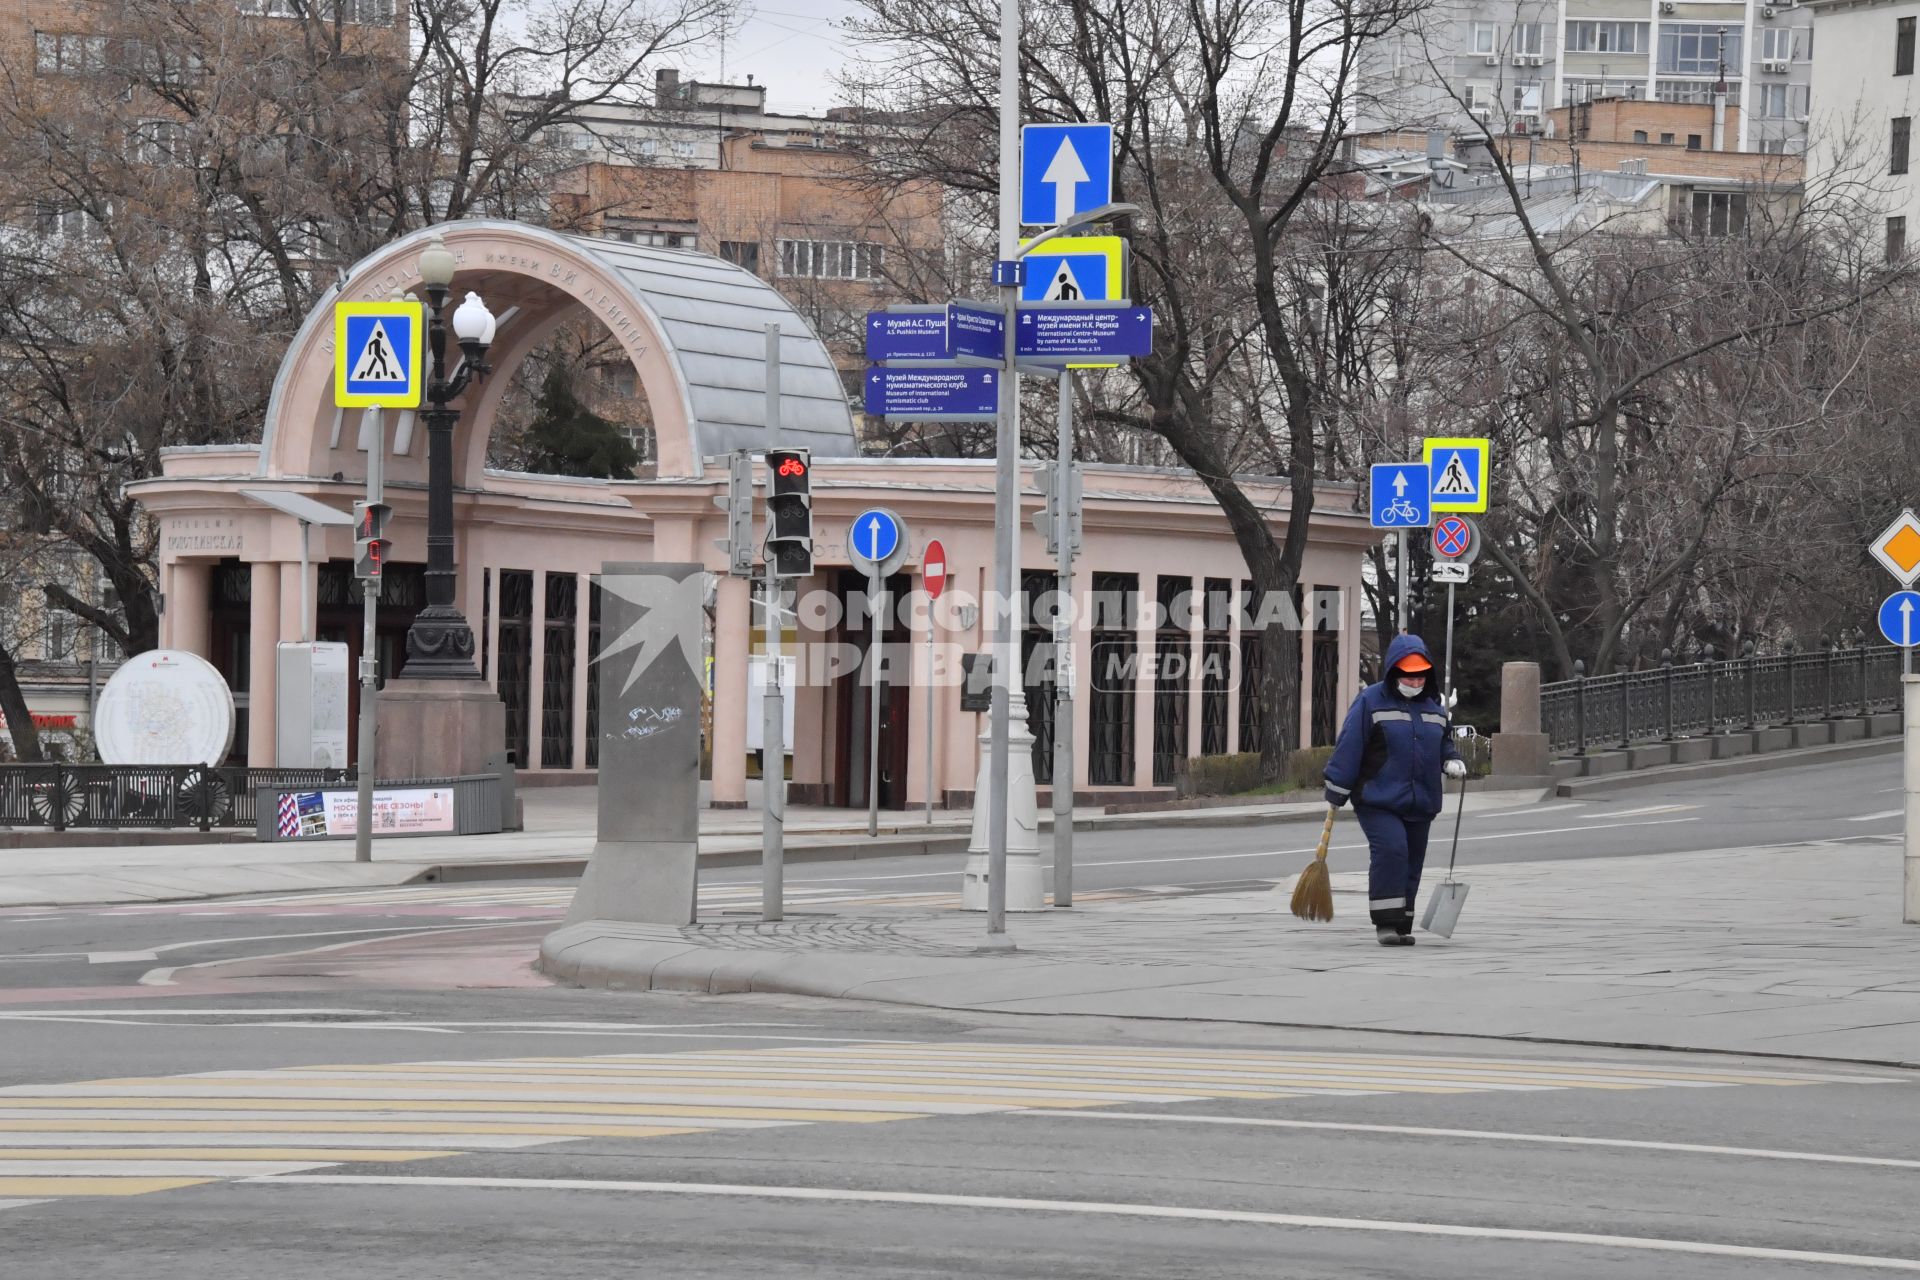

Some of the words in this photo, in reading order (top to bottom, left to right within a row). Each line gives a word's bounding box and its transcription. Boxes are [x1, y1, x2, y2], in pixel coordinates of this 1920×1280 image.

[583, 286, 648, 357] ЛЕНИНА
[1037, 314, 1094, 323] Международный
[1095, 314, 1119, 323] центр-
[887, 319, 911, 329] Музей
[926, 320, 947, 329] Пушк
[1037, 322, 1057, 330] музей
[1095, 322, 1119, 330] Рериха
[886, 374, 907, 382] Музей
[908, 374, 965, 382] Международного
[949, 382, 968, 390] клуба
[390, 802, 423, 810] СЕЗОНЫ
